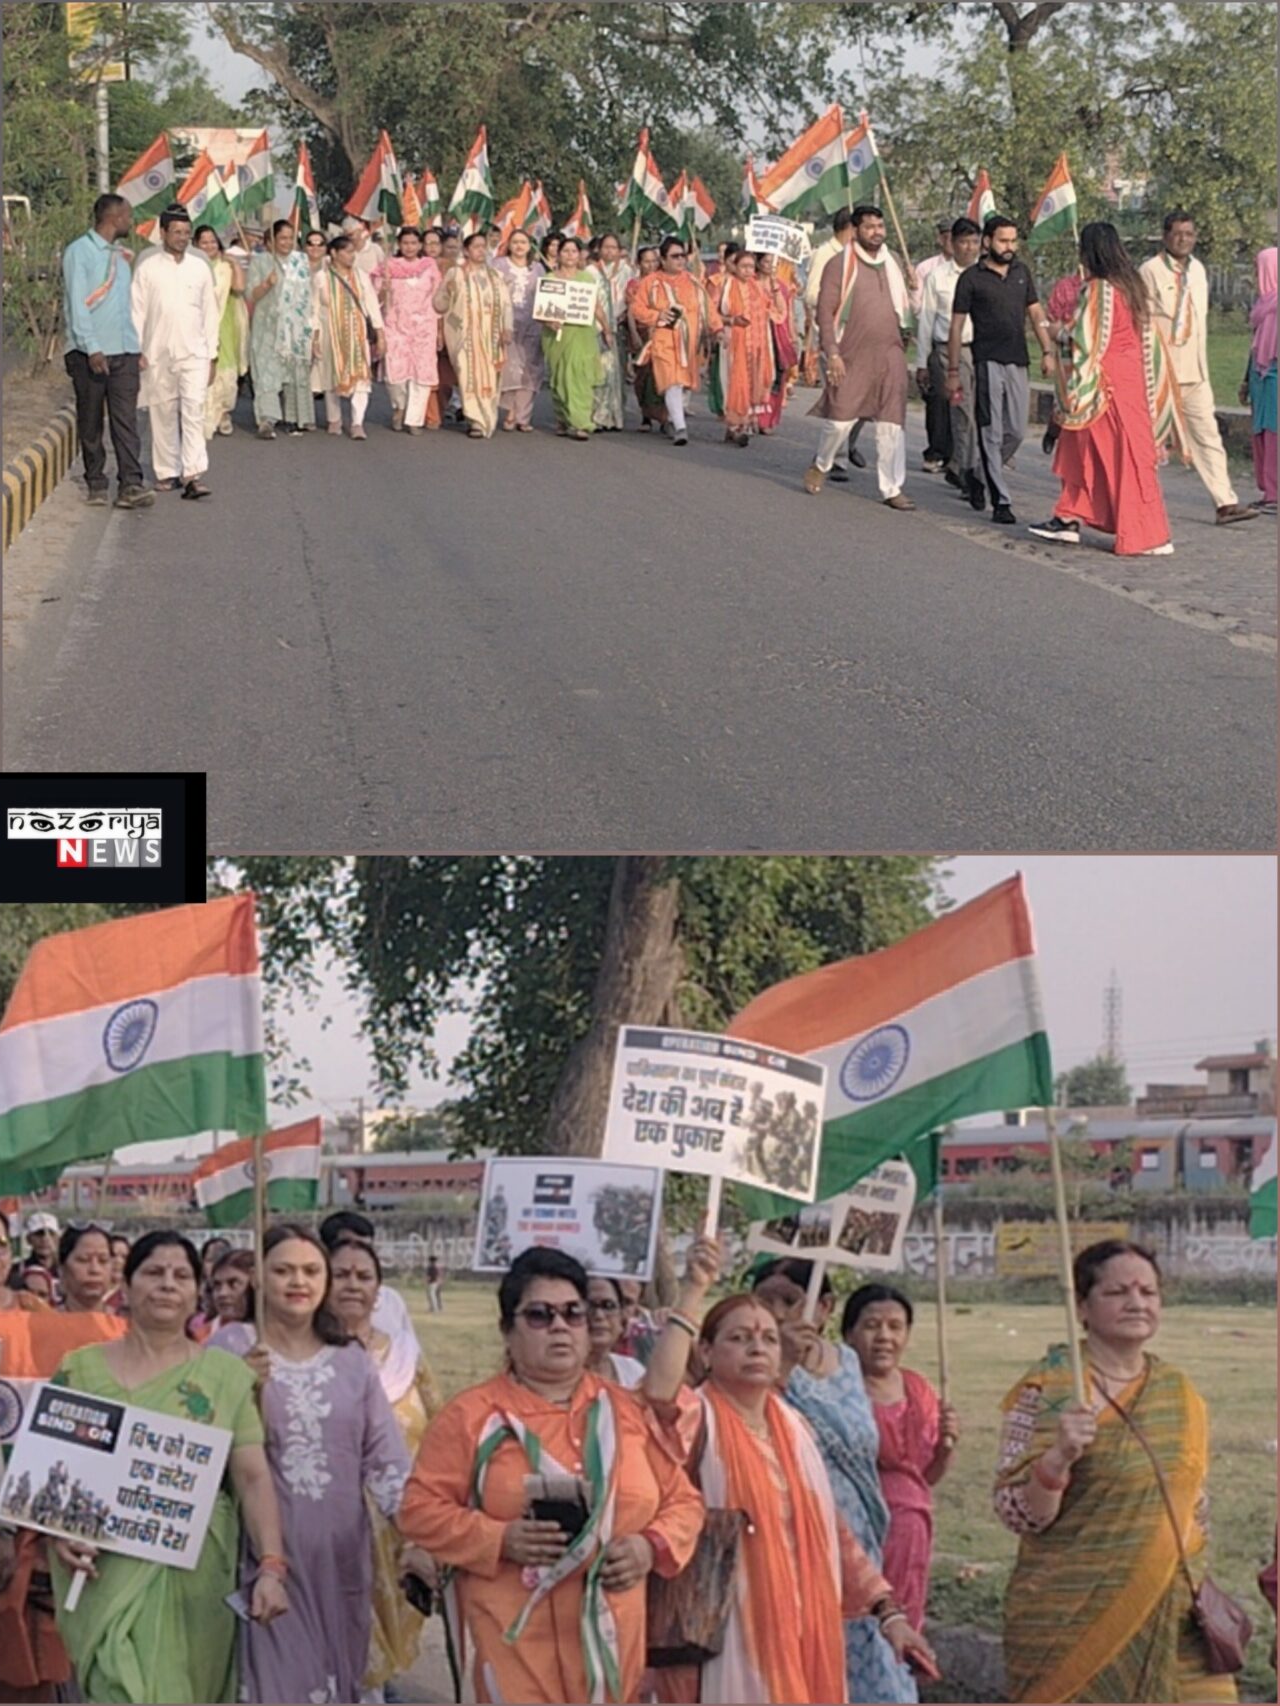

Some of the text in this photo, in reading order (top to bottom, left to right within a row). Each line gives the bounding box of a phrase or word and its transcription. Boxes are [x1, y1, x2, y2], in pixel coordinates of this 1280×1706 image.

[622, 1081, 657, 1114] देश
[659, 1085, 687, 1117] की
[690, 1096, 726, 1123] अब
[634, 1118, 725, 1158] एक पुकार
[128, 1421, 163, 1453] विश्व
[163, 1432, 185, 1459] को
[129, 1458, 157, 1481] एक
[116, 1484, 195, 1523] पाकिस्तान
[106, 1514, 190, 1553] आतंकी देश
